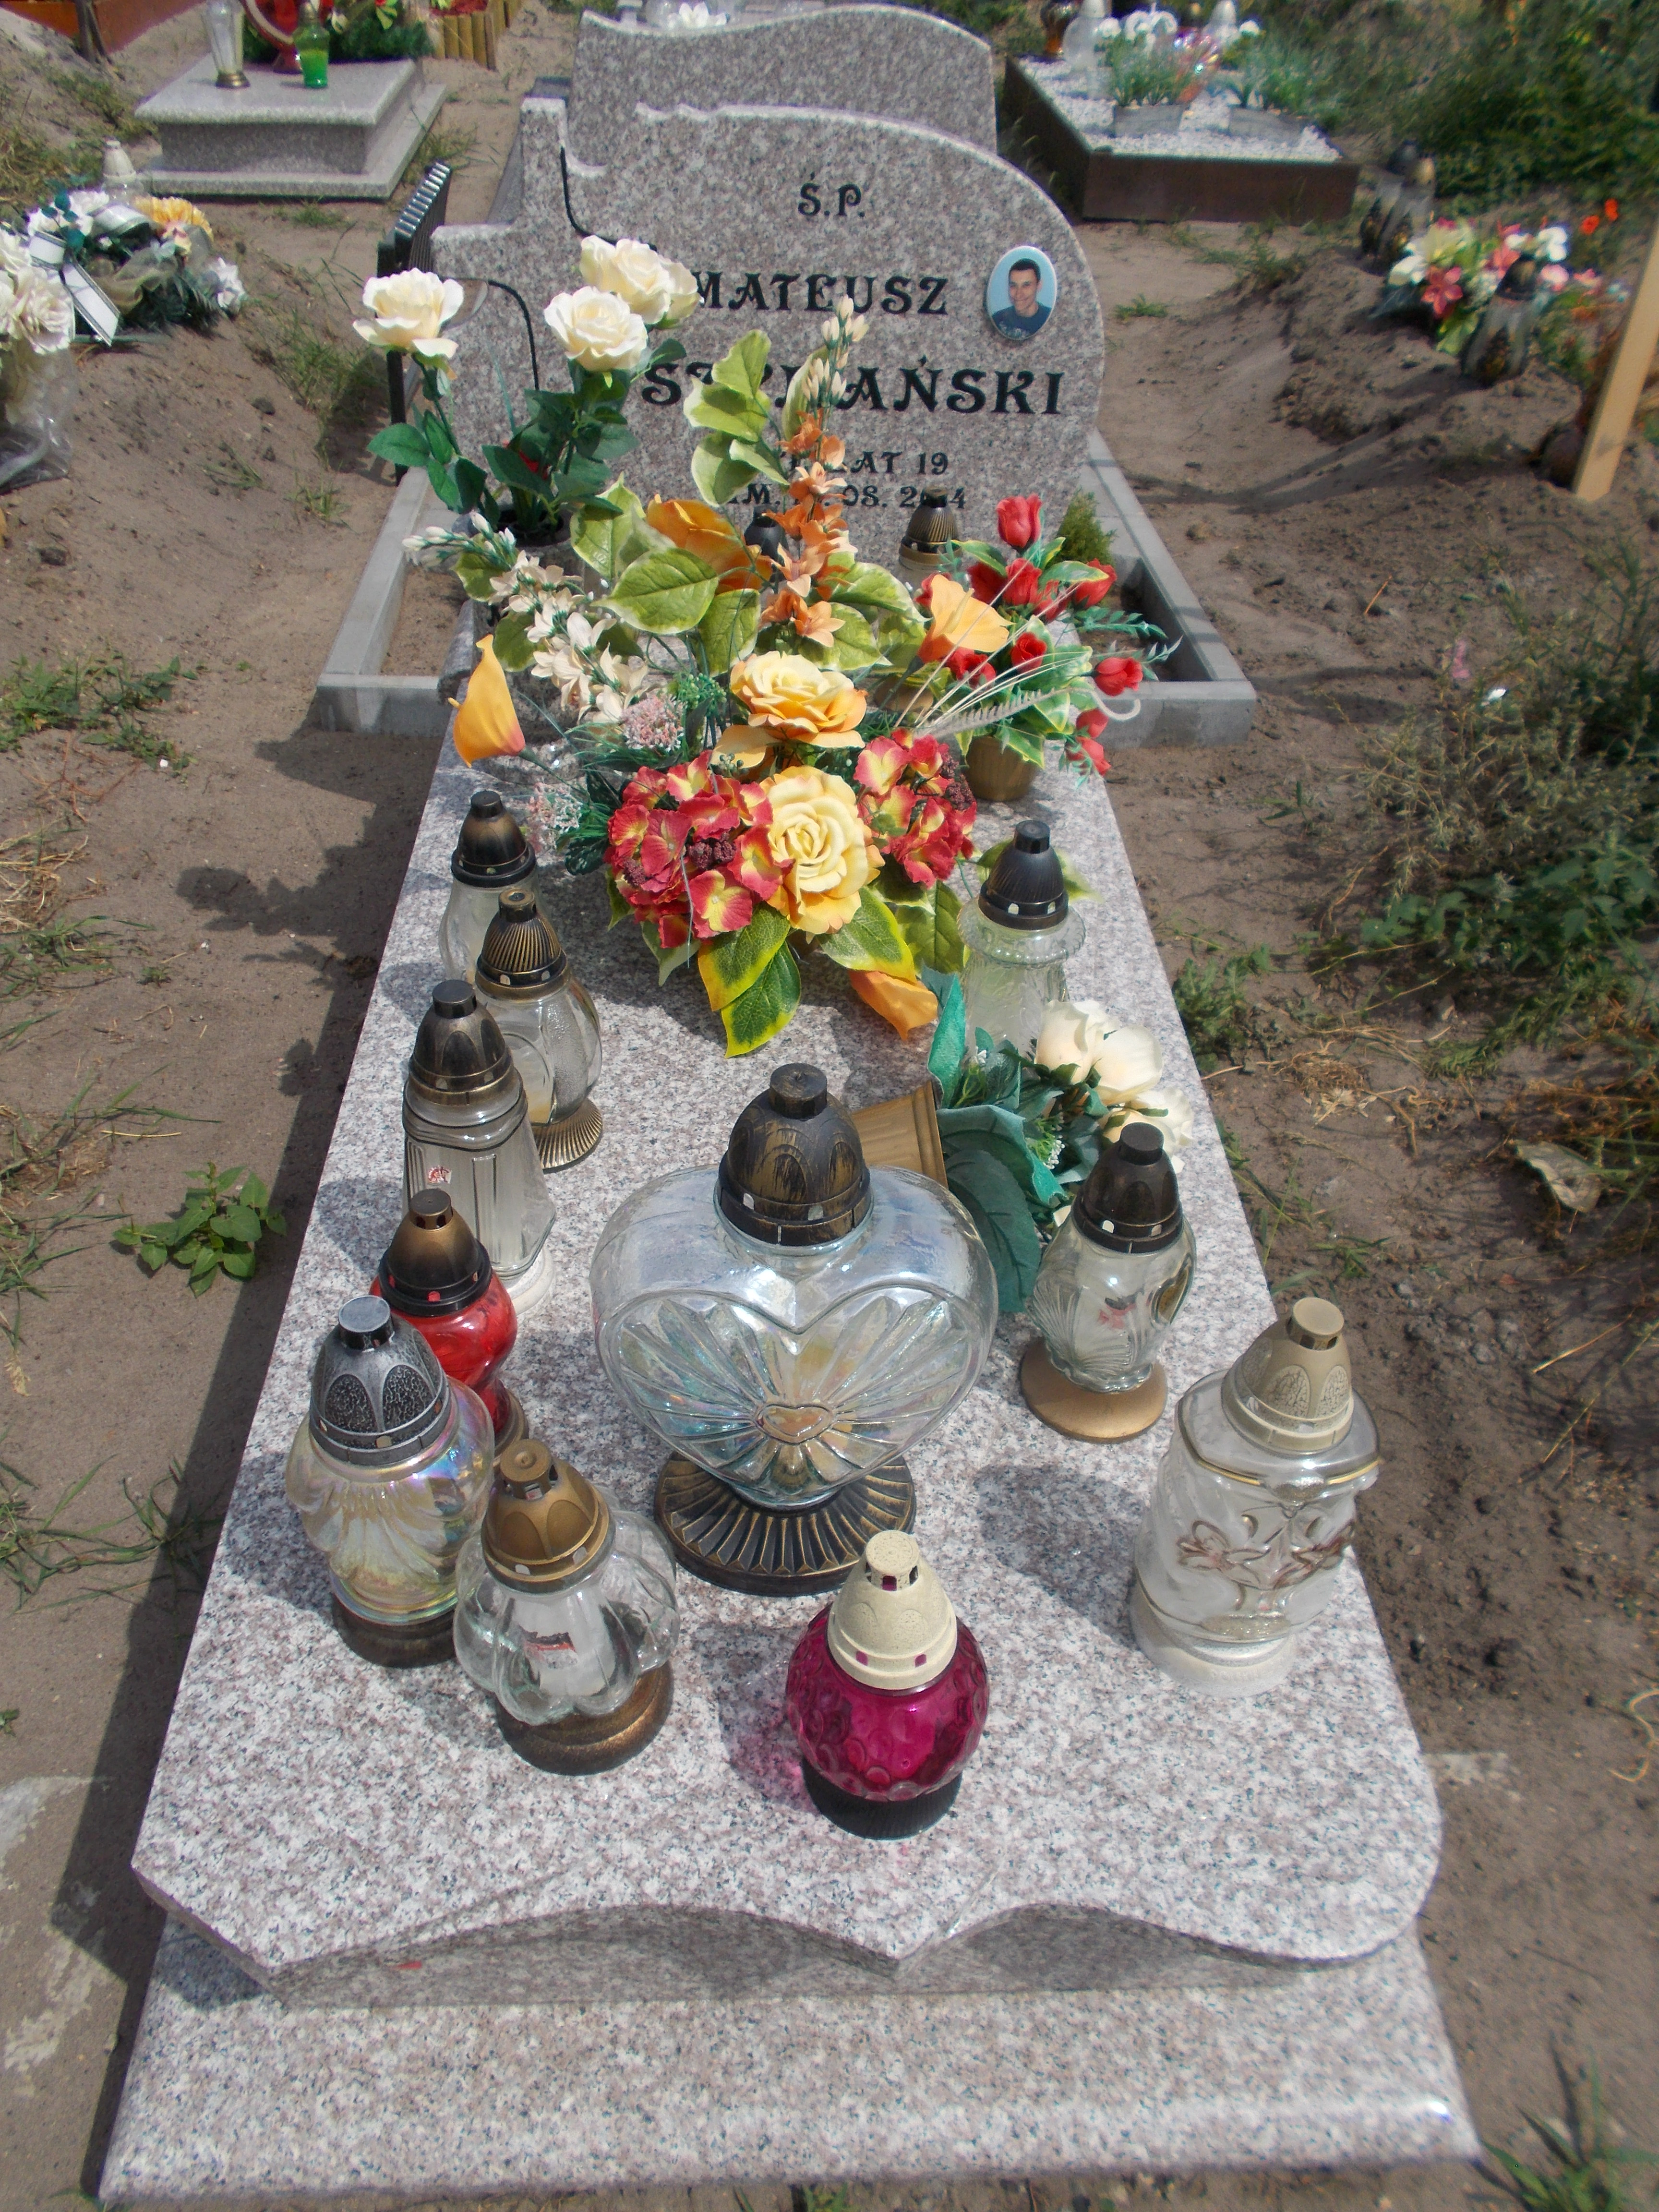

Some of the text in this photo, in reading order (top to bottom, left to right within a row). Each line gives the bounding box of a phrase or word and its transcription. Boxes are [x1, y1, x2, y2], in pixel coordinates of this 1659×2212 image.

[690, 271, 949, 315] MATEUSZ
[642, 355, 1066, 415] SAŃSKI
[833, 451, 902, 474] AT
[918, 452, 949, 475] 19
[728, 483, 781, 505] M.
[899, 485, 966, 509] 24
